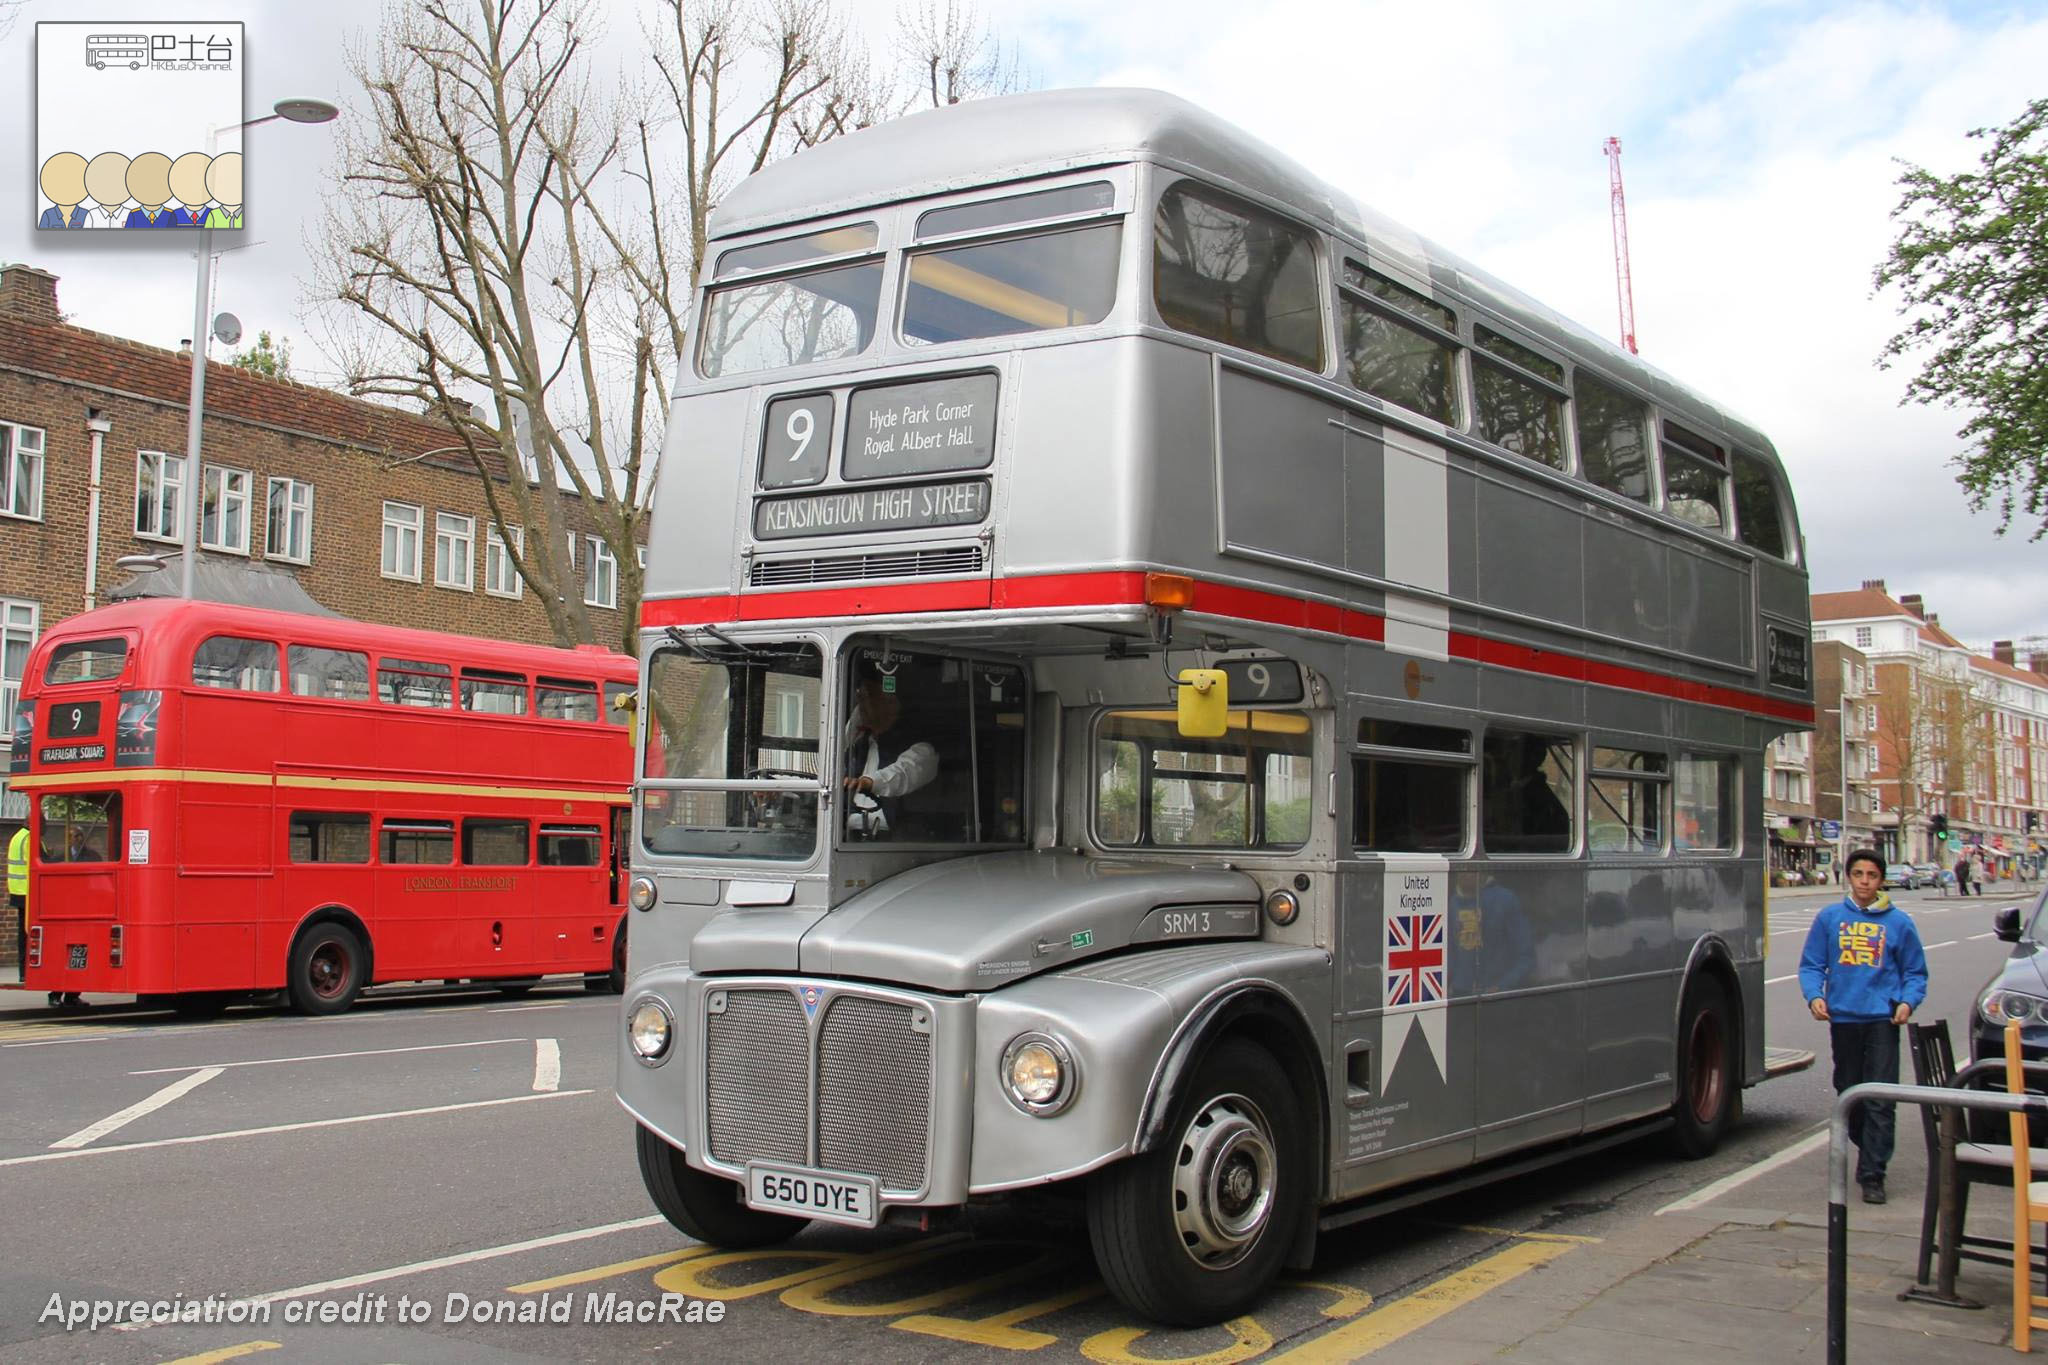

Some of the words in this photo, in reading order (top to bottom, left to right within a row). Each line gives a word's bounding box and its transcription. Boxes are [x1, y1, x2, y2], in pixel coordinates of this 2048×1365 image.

[869, 410, 897, 434] Hyde
[902, 404, 929, 425] Park
[936, 402, 974, 421] Corner
[787, 408, 815, 462] 9
[864, 434, 895, 459] Royal
[901, 430, 942, 450] Albert
[947, 425, 974, 446] Hall
[765, 493, 865, 531] KENSINGTON
[872, 490, 913, 521] HIGH
[921, 483, 984, 517] STREET
[899, 654, 913, 664] EXIT
[1770, 631, 1777, 665] 9
[1247, 663, 1270, 698] 9
[71, 708, 82, 730] 9
[43, 748, 78, 761] TRAFALGAR
[80, 745, 105, 759] SQUARE
[405, 876, 453, 892] LONDON
[459, 876, 518, 891] TRANSPORT
[1404, 876, 1430, 890] United
[1400, 894, 1433, 911] Kingdom
[1164, 912, 1198, 934] SRM
[1201, 911, 1210, 932] 3
[1839, 921, 1880, 937] NO
[71, 957, 86, 968] DYE
[763, 1175, 807, 1204] 650
[814, 1182, 858, 1213] DYE
